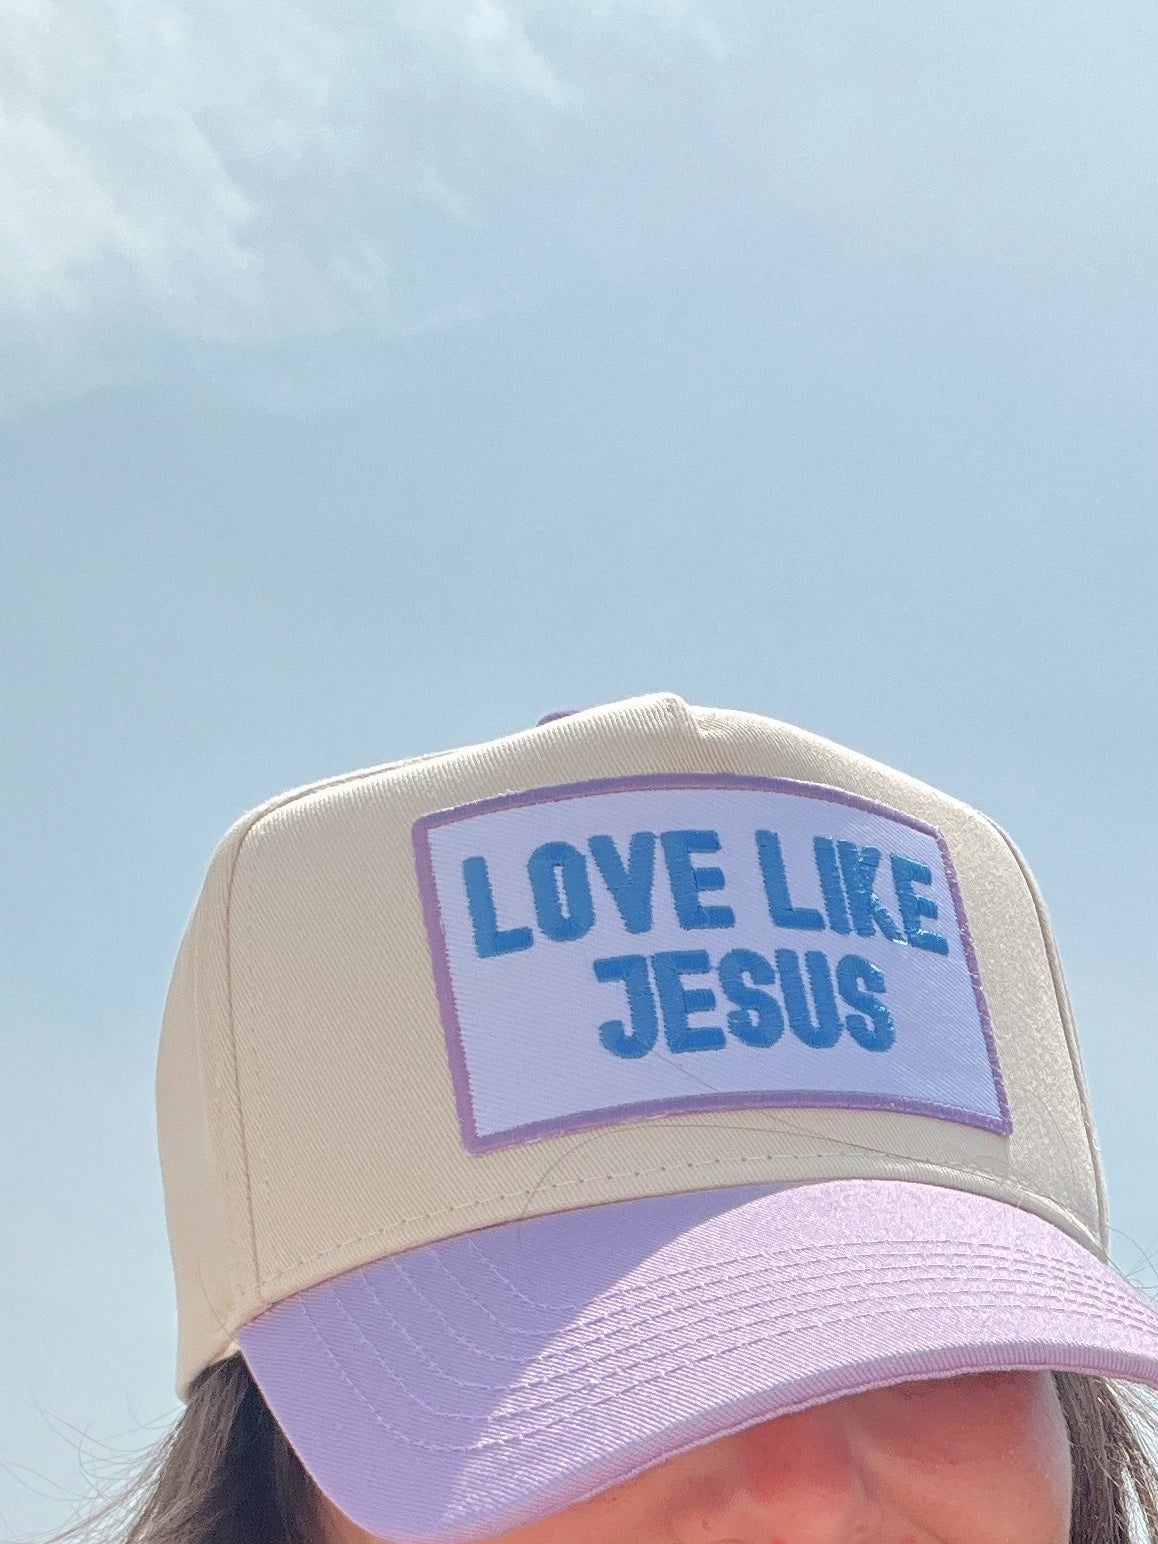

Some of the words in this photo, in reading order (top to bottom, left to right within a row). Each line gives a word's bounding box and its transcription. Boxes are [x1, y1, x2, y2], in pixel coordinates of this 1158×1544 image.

[462, 829, 735, 958] LOVE
[755, 829, 949, 955] LIKE
[593, 948, 896, 1059] JESUS
